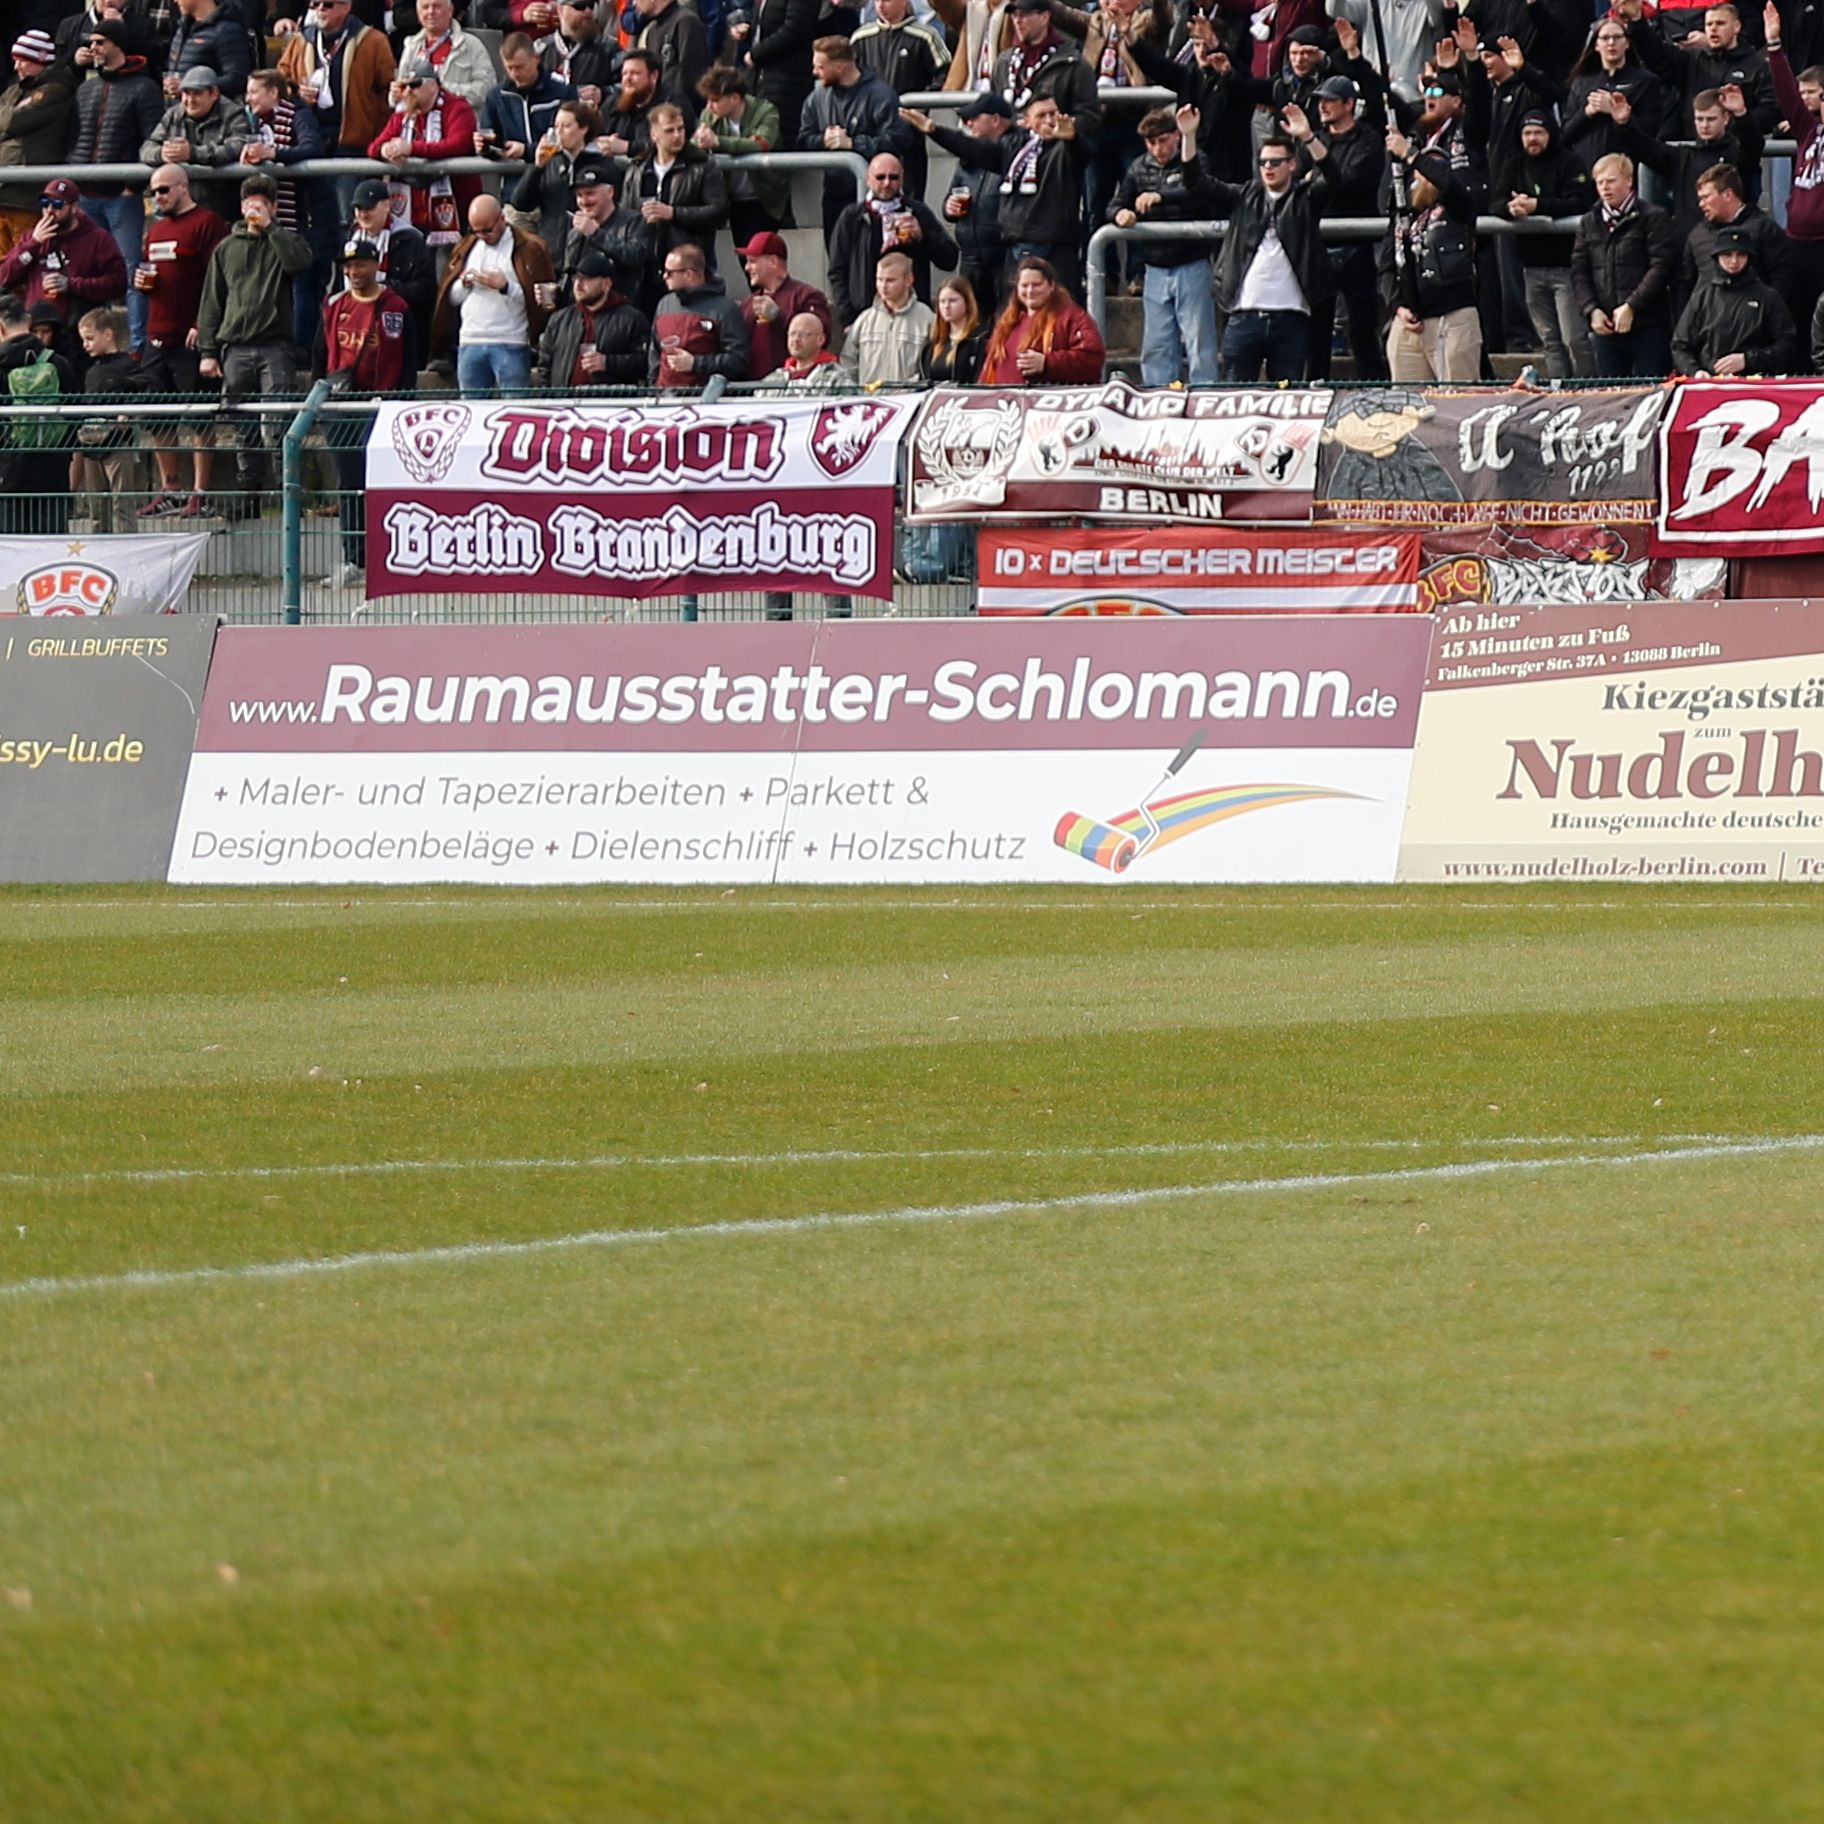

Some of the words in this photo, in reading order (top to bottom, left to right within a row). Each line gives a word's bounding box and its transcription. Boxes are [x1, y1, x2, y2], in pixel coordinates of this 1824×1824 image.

[404, 405, 460, 429] BFC
[1034, 386, 1186, 415] DYNAMO
[1194, 388, 1333, 419] FAMILIE
[485, 406, 784, 481] Division
[1100, 486, 1224, 518] BERLIN
[385, 502, 543, 578] Berlin
[551, 500, 876, 587] Brandenburg
[994, 548, 1025, 575] 10
[1050, 548, 1253, 575] DEUTSCHER
[1256, 546, 1398, 575] MEISTER
[31, 570, 107, 604] BFC
[1441, 615, 1473, 636] Ab
[1476, 613, 1521, 632] hier
[27, 637, 169, 658] GRILLBUFFETS
[1440, 642, 1464, 659] 15
[1468, 635, 1555, 657] Minuten
[1557, 633, 1584, 649] zu
[1587, 624, 1632, 646] Fuß
[1437, 660, 1545, 682] Falkenberger
[1546, 656, 1573, 671] Str.
[1576, 653, 1607, 668] 37A
[1622, 648, 1669, 665] 13088
[1670, 642, 1722, 661] Berlin
[229, 657, 1398, 725] www.Raumausstatter-Schlomann.de
[1693, 728, 1732, 740] zum
[0, 733, 144, 769] ssy-lu.de
[239, 776, 345, 807] Maler-
[357, 776, 426, 808] und
[438, 776, 726, 814] Tapezierarbeiten
[765, 776, 905, 807] Parkett
[907, 776, 930, 807] &
[1549, 810, 1718, 837] Hausgemachte
[1721, 809, 1824, 831] deutsche
[191, 829, 534, 867] Designbodenbeläge
[570, 829, 796, 862] Dielenschliff
[828, 829, 1027, 861] Holzschutz
[1443, 855, 1768, 877] www.nudelholz-berlin.com
